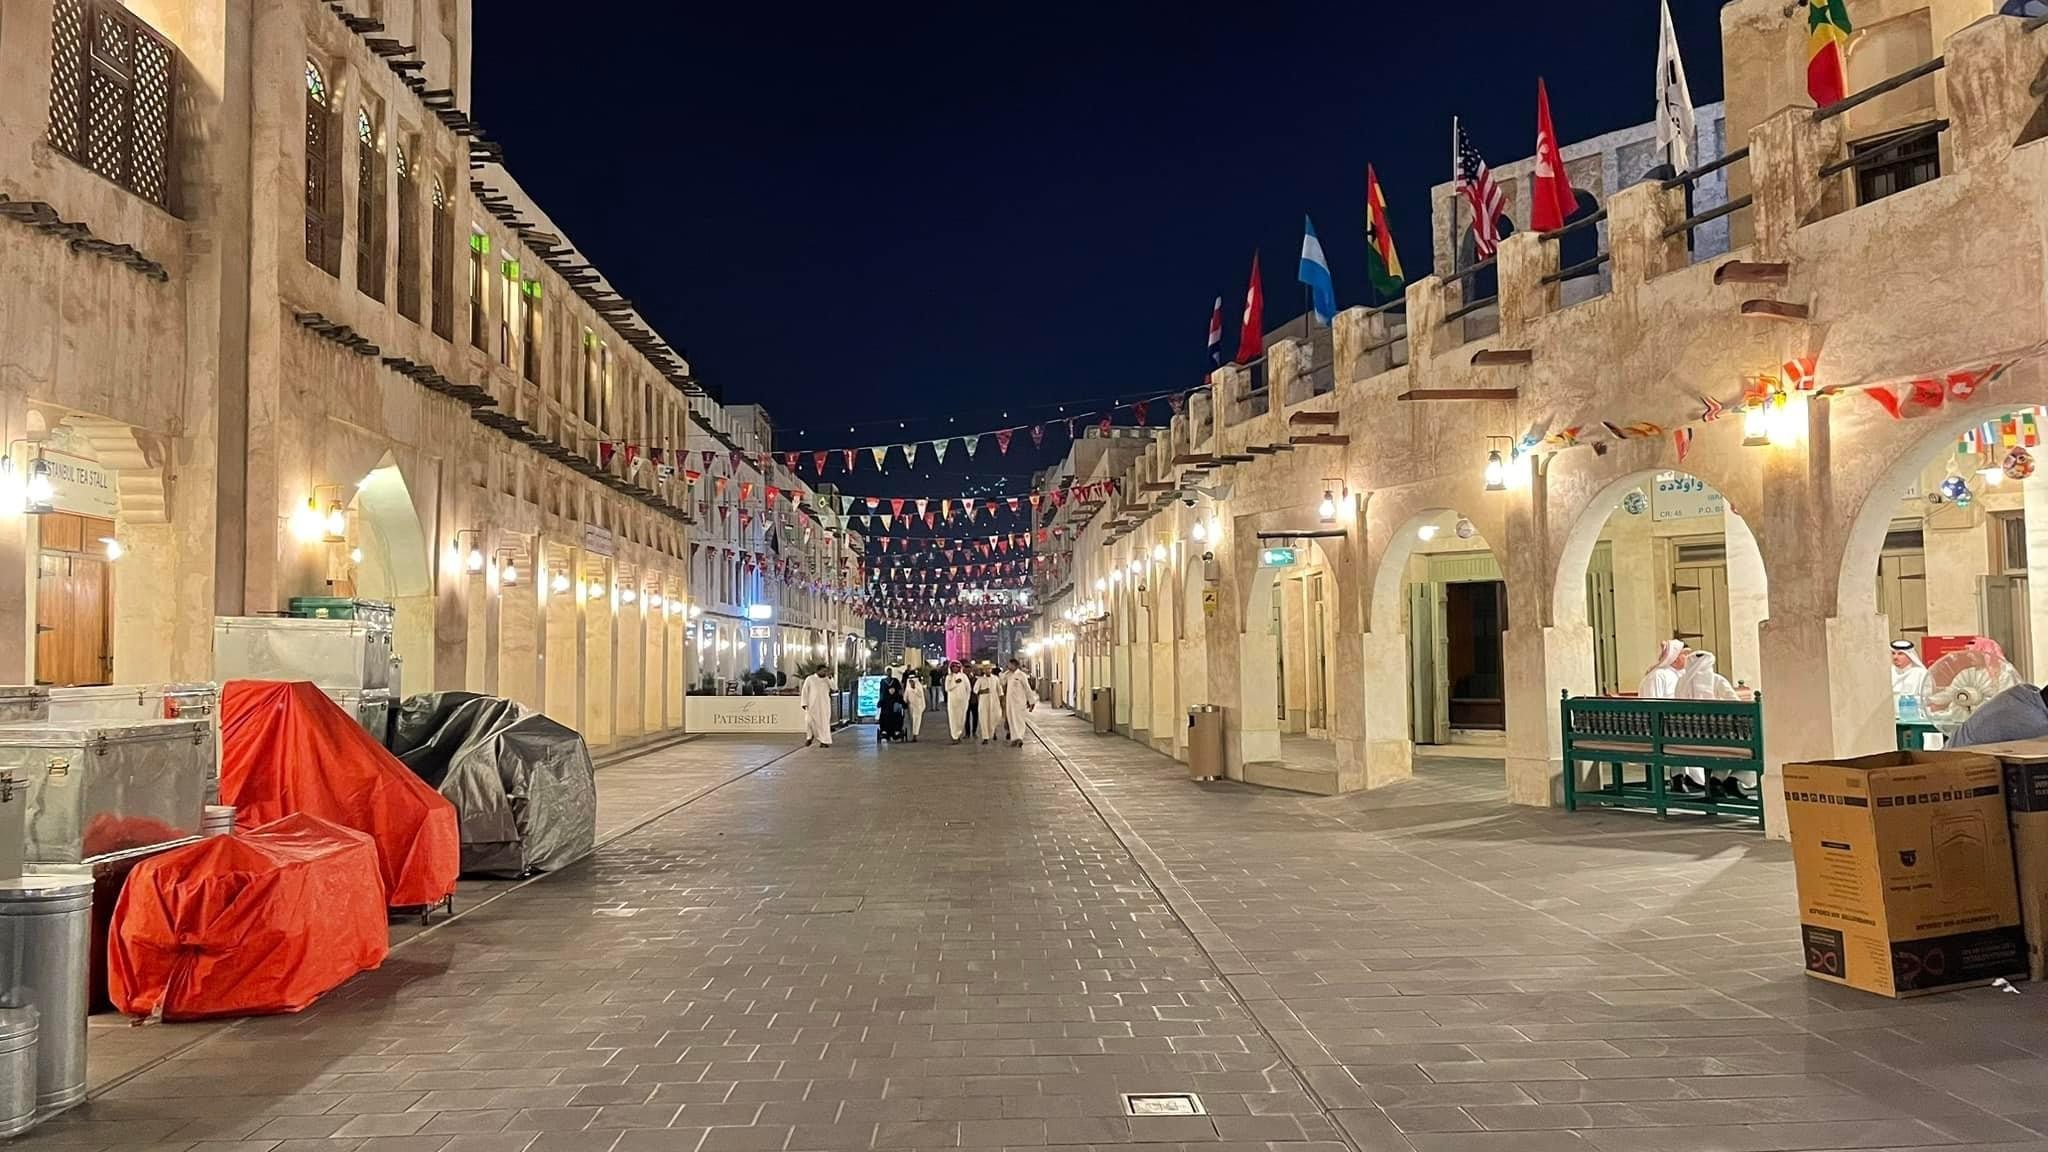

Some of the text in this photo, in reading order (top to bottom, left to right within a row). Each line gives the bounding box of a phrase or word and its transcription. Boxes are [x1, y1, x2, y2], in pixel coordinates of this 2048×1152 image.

[46, 461, 108, 489] STANBUL TEA STALL
[713, 713, 778, 725] PATISSERIE
